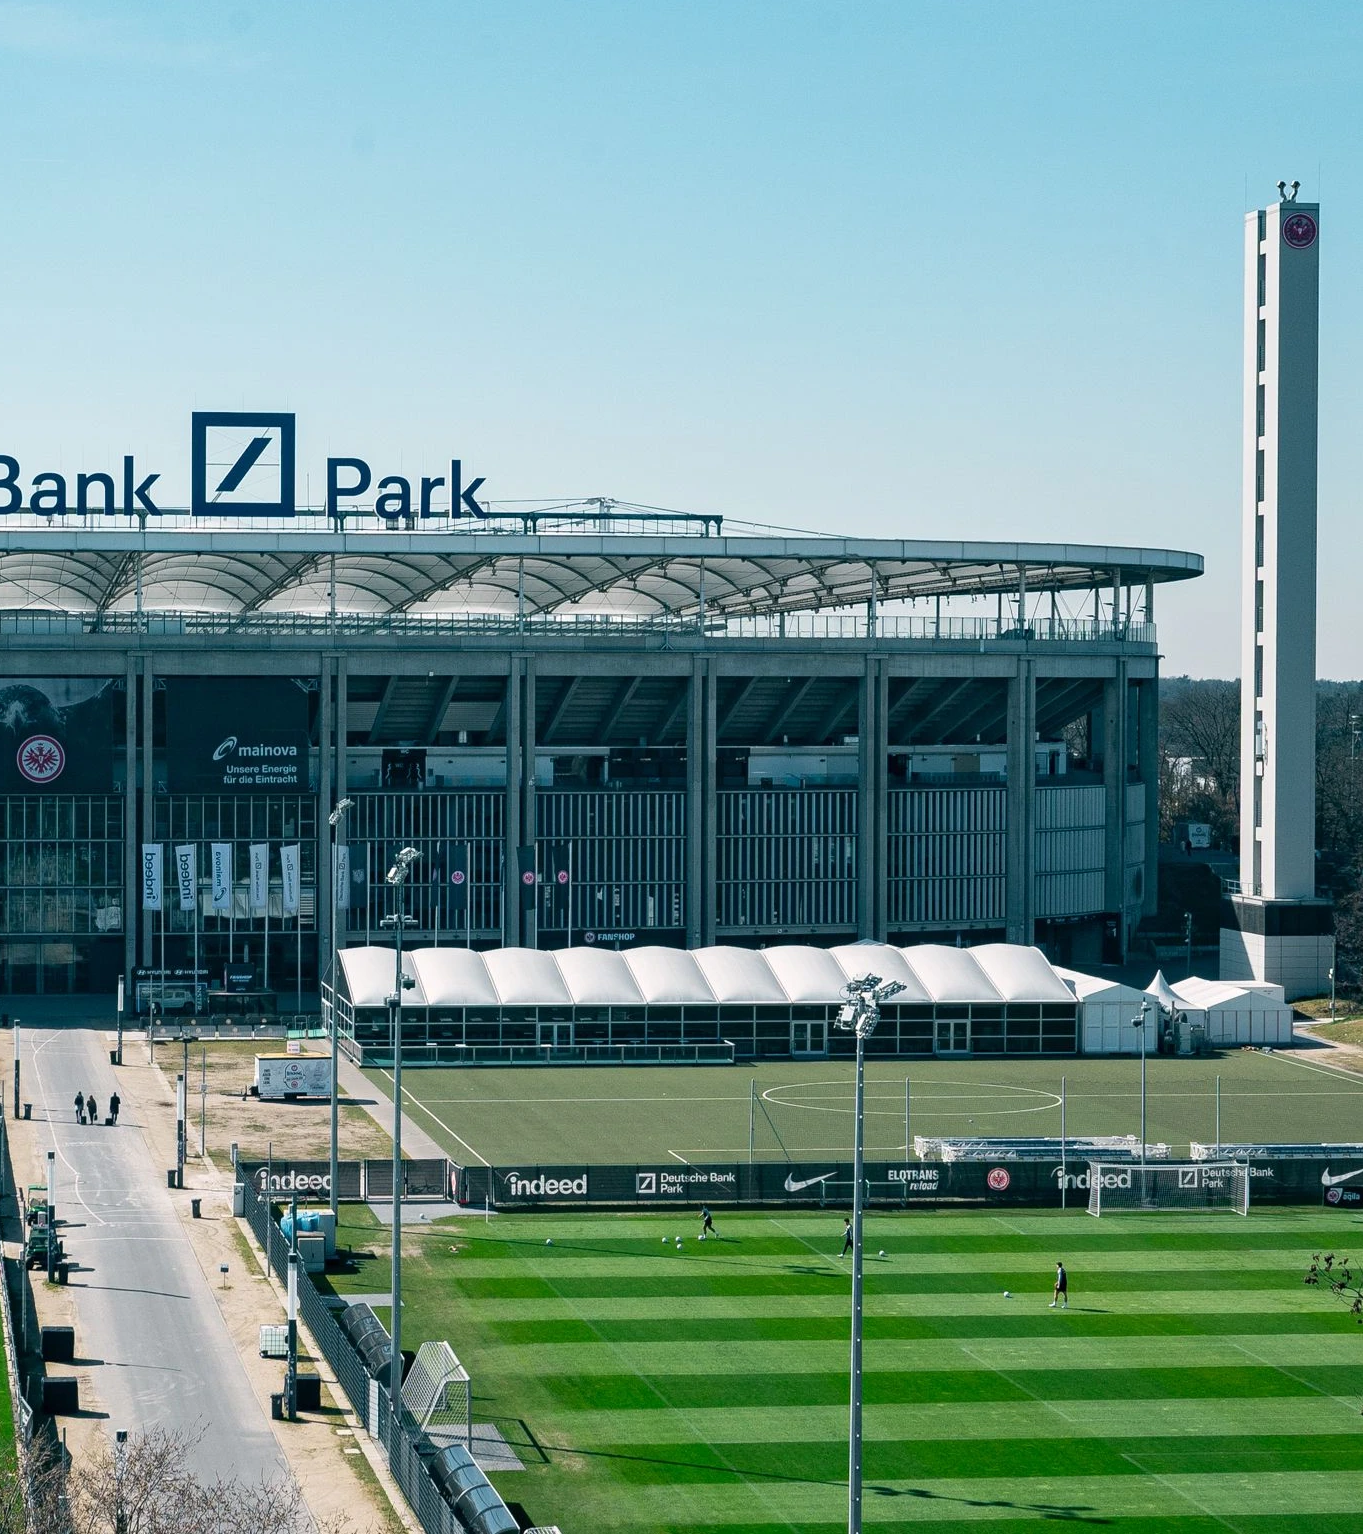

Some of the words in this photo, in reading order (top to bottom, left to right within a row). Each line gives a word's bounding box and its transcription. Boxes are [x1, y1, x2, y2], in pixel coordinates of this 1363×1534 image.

[327, 456, 487, 519] Park
[238, 743, 297, 757] mainova
[226, 765, 259, 773] Unsere
[262, 765, 297, 775] Energie
[223, 775, 236, 784] für
[238, 775, 253, 783] die
[255, 775, 297, 783] Eintracht
[597, 933, 635, 941] FANSHOP
[888, 1170, 939, 1180] ELOTRANS
[1202, 1167, 1246, 1177] Deutsche
[1249, 1167, 1274, 1177] Bank
[661, 1173, 708, 1183] Deutsche
[710, 1173, 735, 1182] Bank
[507, 1172, 587, 1195] indeed
[910, 1181, 938, 1190] reload
[1202, 1179, 1224, 1188] Park
[661, 1184, 683, 1194] Park
